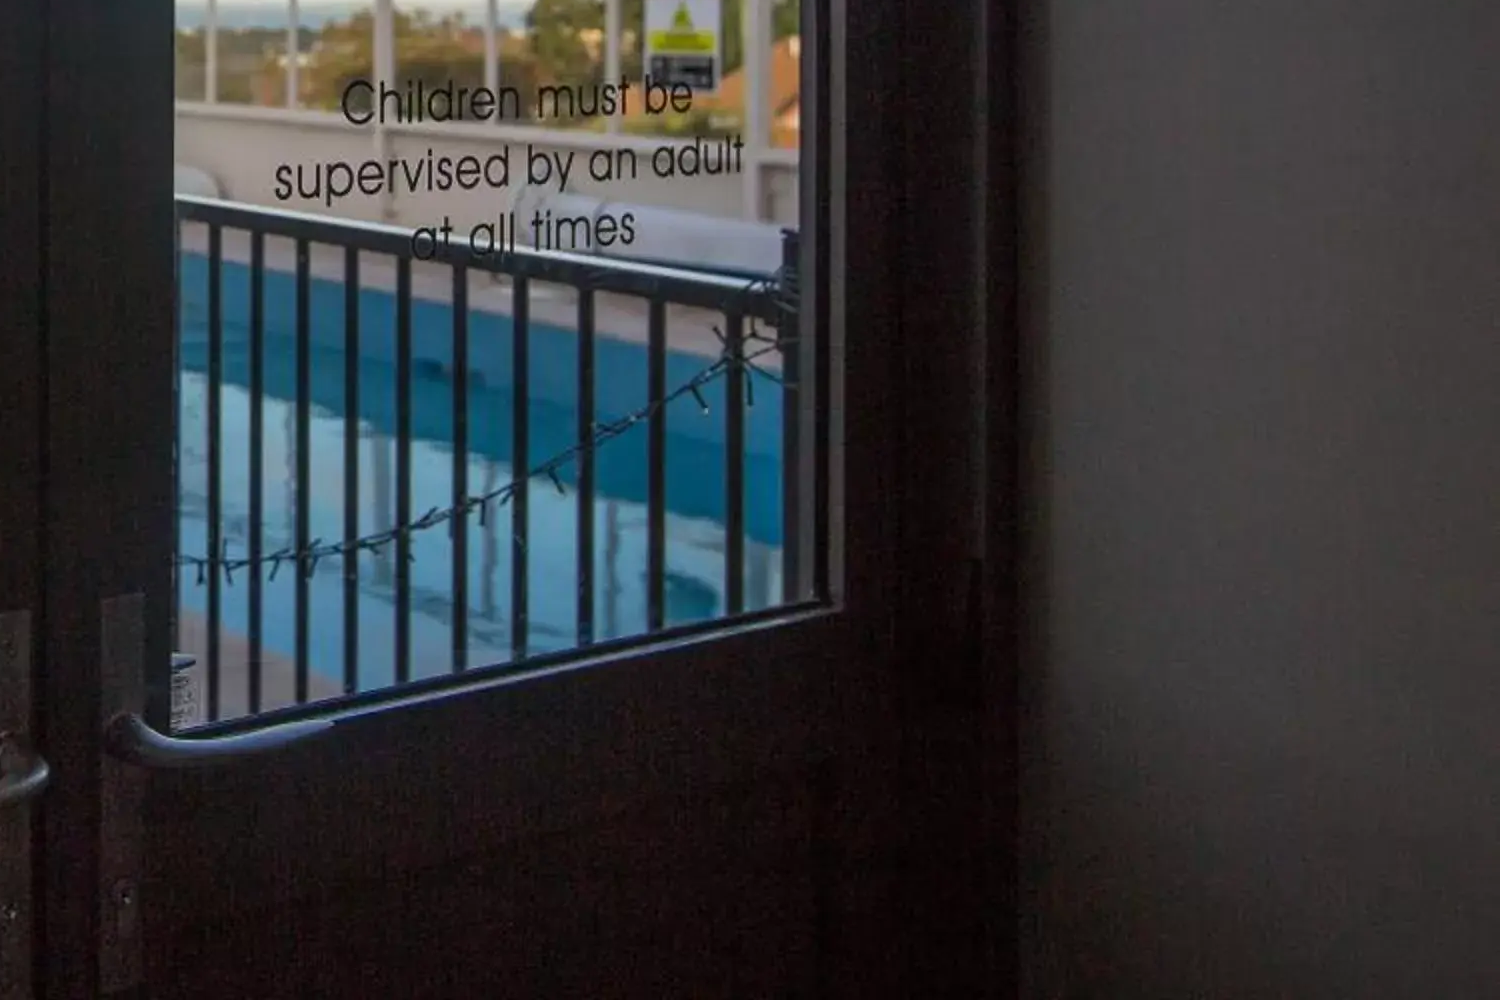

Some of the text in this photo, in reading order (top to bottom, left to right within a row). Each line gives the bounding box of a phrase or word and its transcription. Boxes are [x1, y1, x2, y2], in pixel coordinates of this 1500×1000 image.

[341, 74, 692, 125] Children must be
[274, 136, 744, 207] supervised by an adult
[411, 209, 635, 261] at all times
